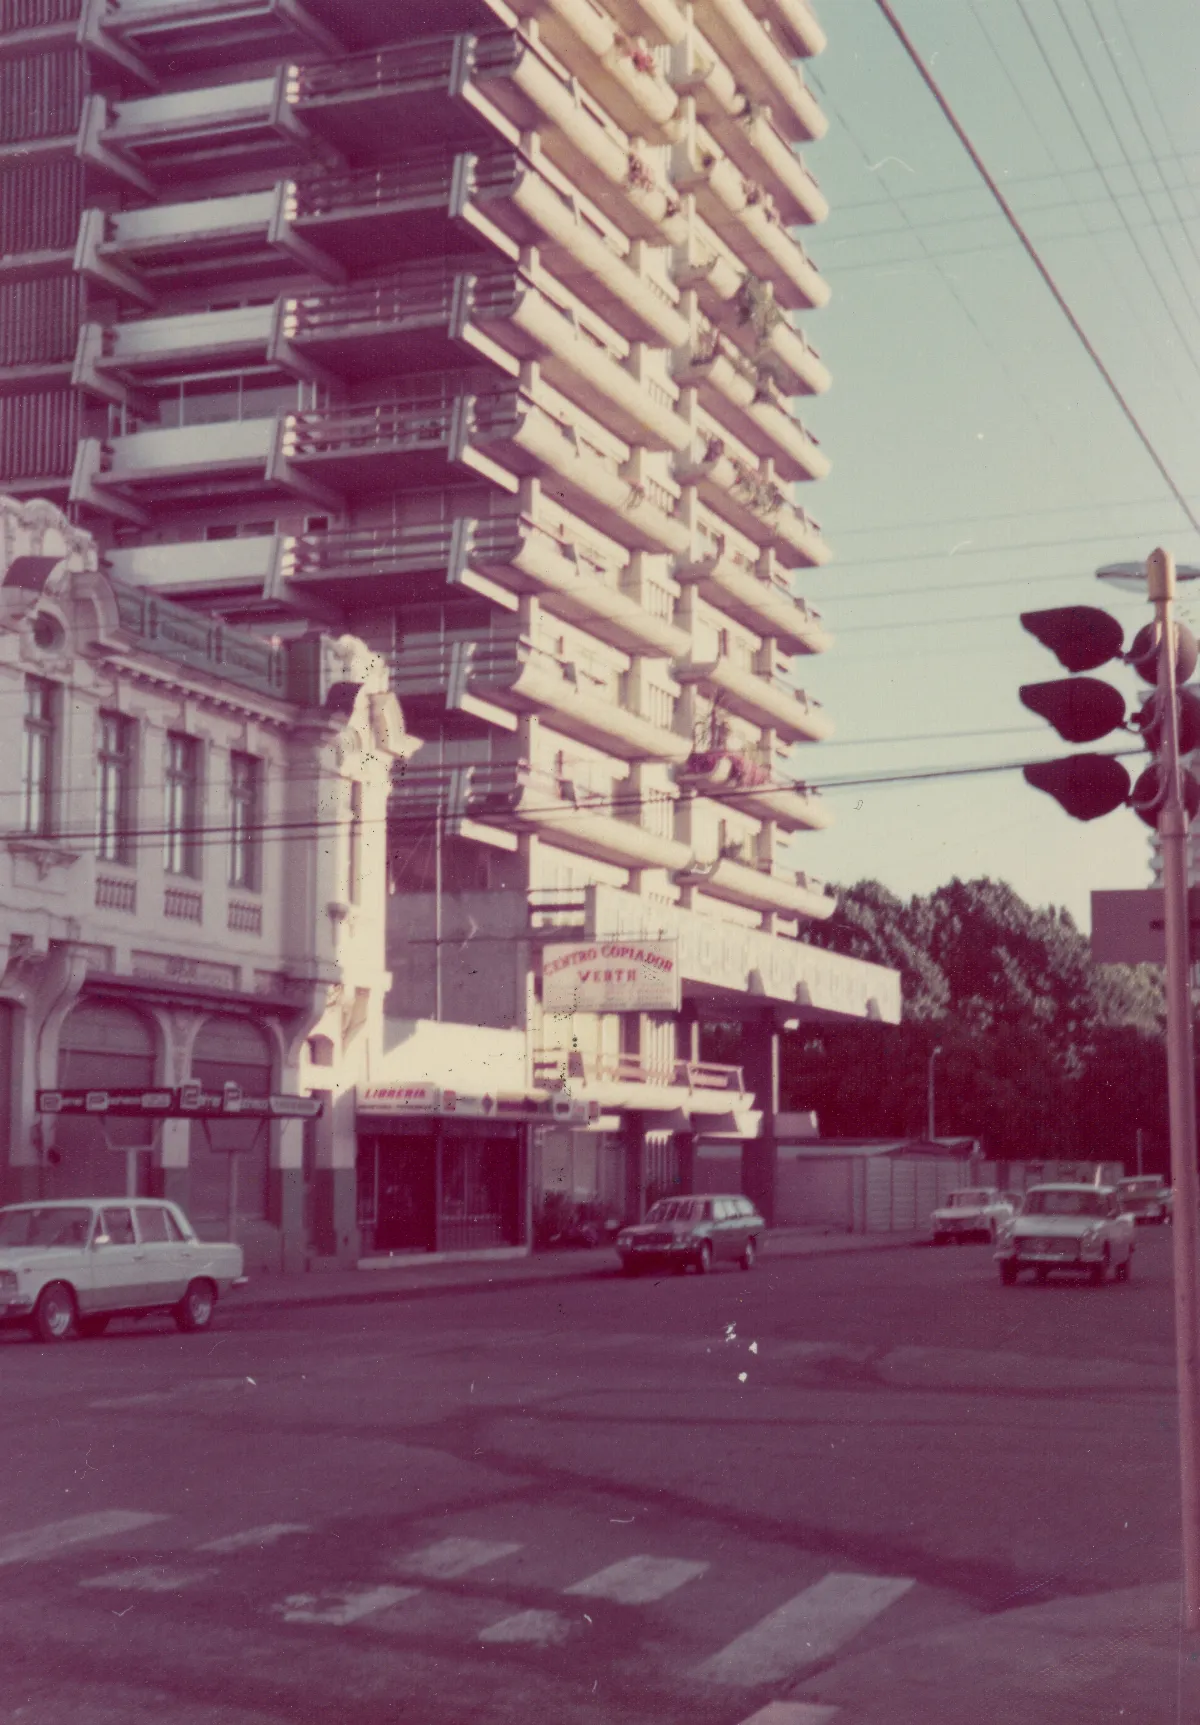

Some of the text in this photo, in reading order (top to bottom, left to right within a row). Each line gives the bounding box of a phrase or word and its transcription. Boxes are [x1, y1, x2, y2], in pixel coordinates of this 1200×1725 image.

[543, 944, 673, 975] CENTRO COPIADOR
[364, 1088, 426, 1099] LIBRERIA
